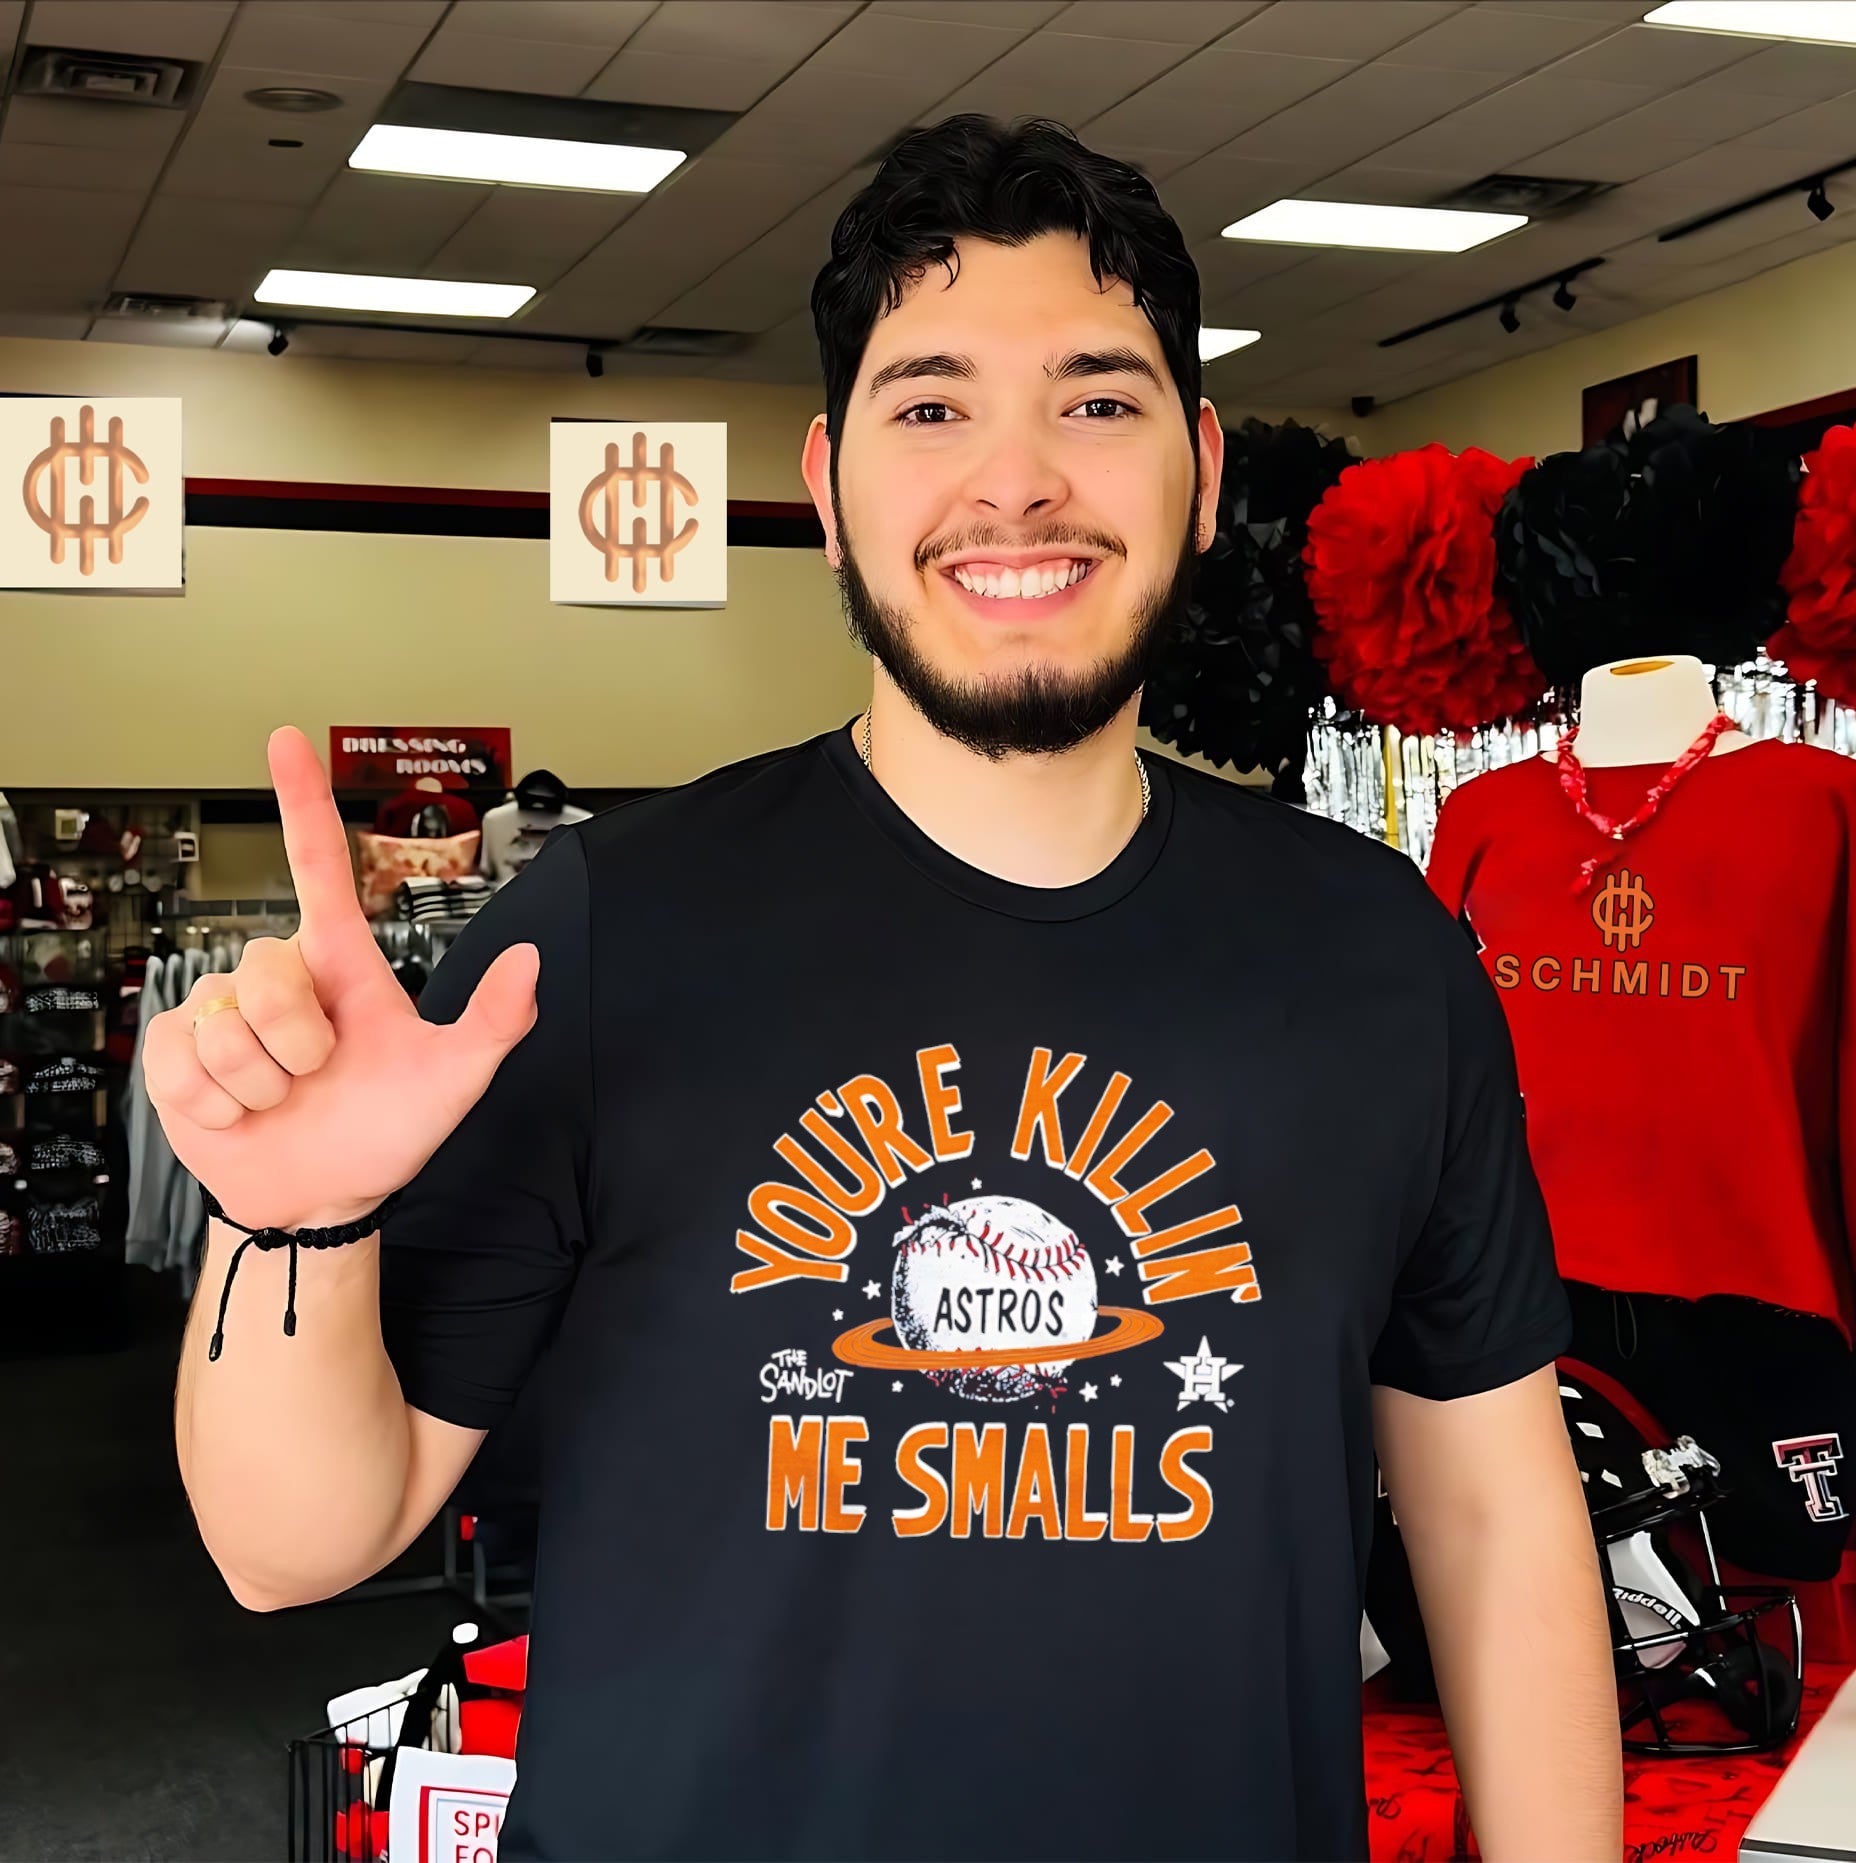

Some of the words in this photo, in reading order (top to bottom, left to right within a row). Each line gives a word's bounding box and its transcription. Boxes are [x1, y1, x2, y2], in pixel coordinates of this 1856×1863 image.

[342, 737, 467, 754] DRESSING
[396, 758, 487, 775] ROOMS
[1494, 953, 1747, 1001] SCHMIDT
[730, 1043, 975, 1293] YOU'RE
[1010, 1046, 1262, 1305] KILLIN'
[933, 1286, 1065, 1337] ASTROS
[771, 1348, 807, 1367] THE
[759, 1362, 854, 1403] SANDLOT
[766, 1415, 870, 1533] ME
[891, 1421, 1213, 1542] SMALLS
